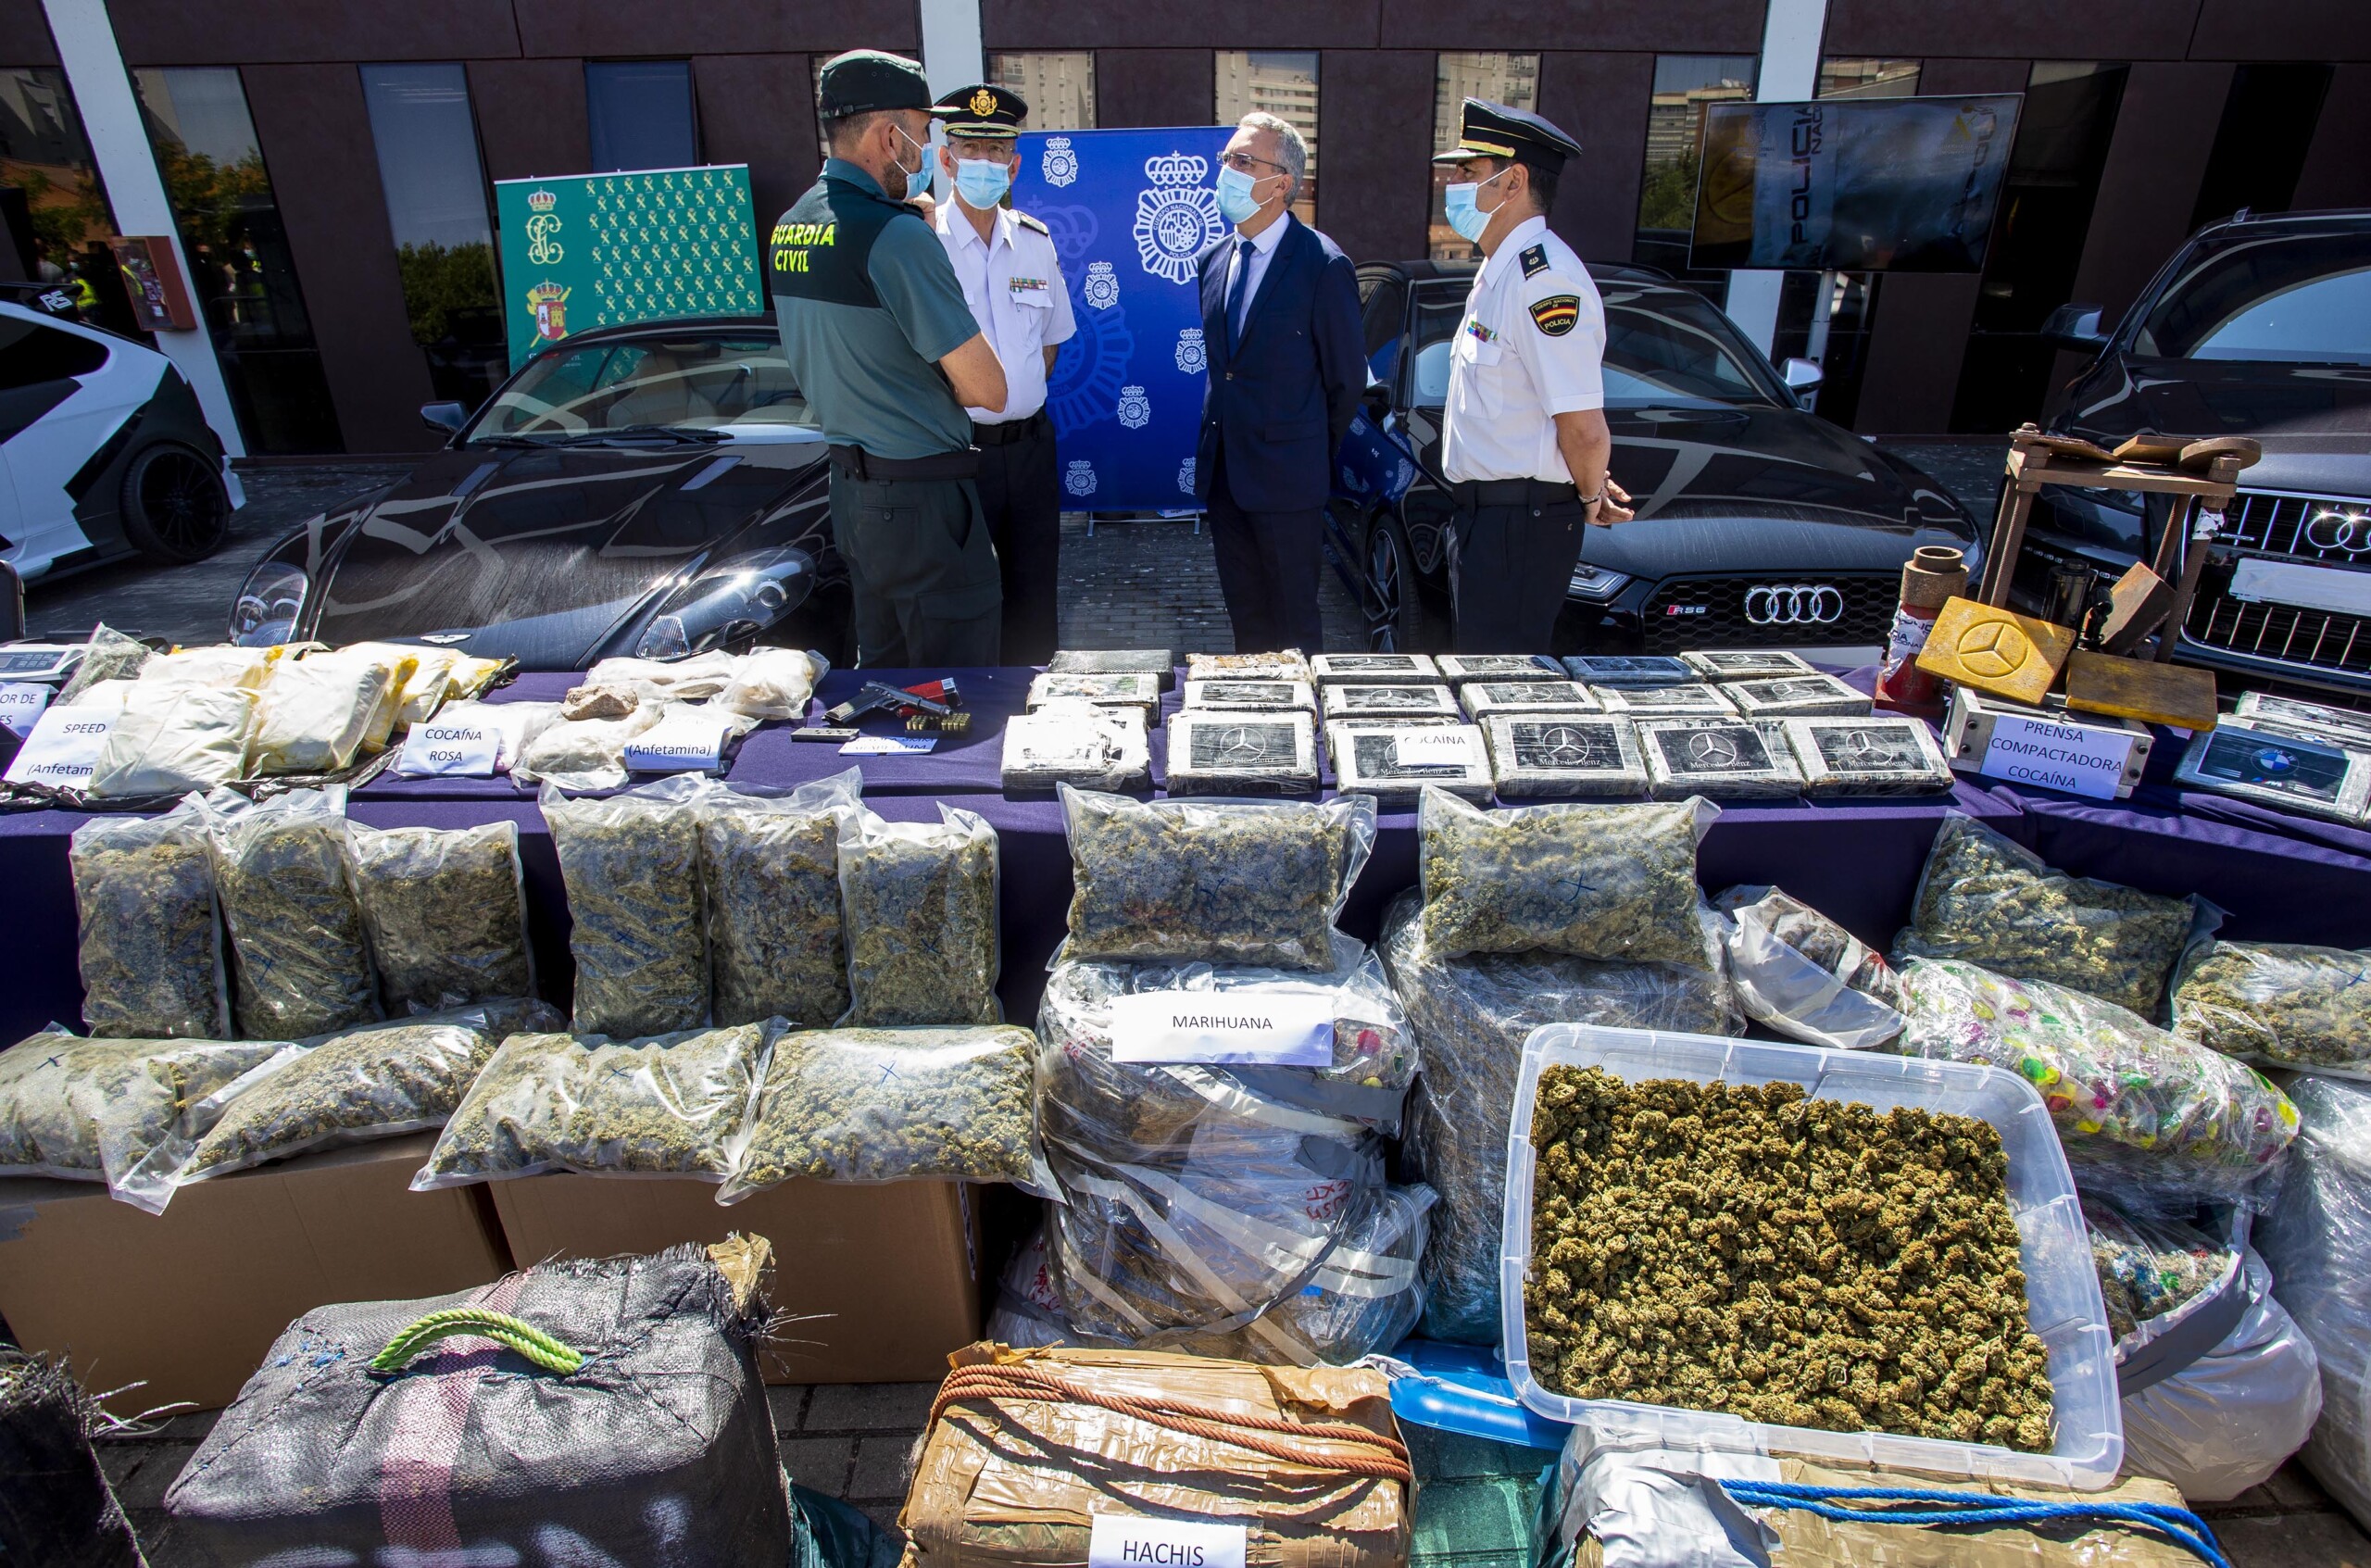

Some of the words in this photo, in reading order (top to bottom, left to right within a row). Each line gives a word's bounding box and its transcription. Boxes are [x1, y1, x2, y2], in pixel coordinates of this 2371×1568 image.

[1153, 207, 1170, 231] CUERPO
[1170, 204, 1199, 220] NACIONAL
[1197, 218, 1205, 228] DE
[771, 223, 835, 246] GUARDIA
[774, 249, 809, 272] CIVIL
[1535, 300, 1552, 311] CUERPO
[1544, 319, 1571, 330] POLICIA
[1670, 606, 1706, 615] RS6
[20, 694, 37, 704] DE
[63, 723, 107, 734] SPEED
[424, 728, 483, 741] COCAÍNA
[2024, 721, 2084, 743] PRENSA
[429, 750, 463, 762] ROSA
[628, 743, 712, 758] (Anfetamina)
[1991, 737, 2122, 772] COMPACTADORA
[27, 763, 94, 776] (Anfetam
[2008, 765, 2076, 788] COCAÍNA
[1173, 1015, 1273, 1030] MARIHUANA
[1123, 1540, 1204, 1567] HACHIS
